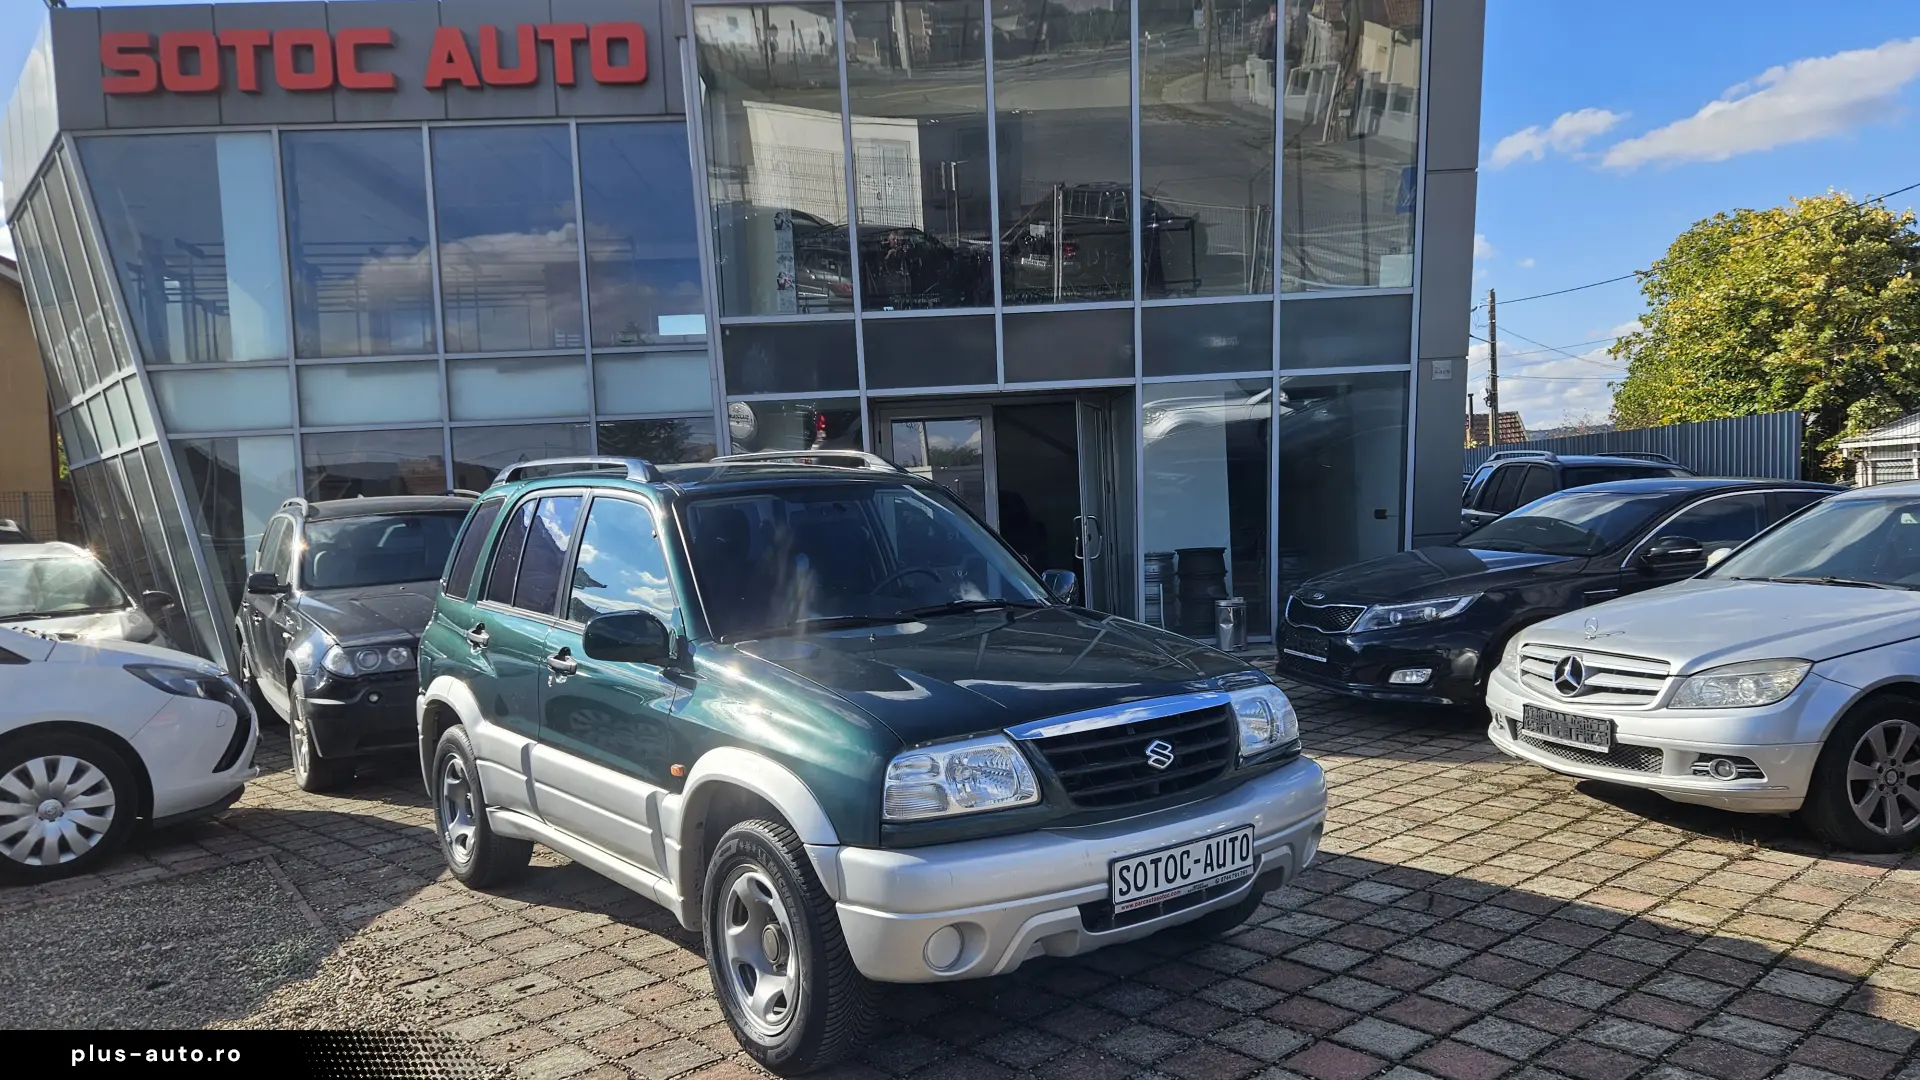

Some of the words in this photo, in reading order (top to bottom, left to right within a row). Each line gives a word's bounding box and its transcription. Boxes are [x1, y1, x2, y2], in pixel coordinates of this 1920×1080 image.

[100, 27, 397, 94] SOTOC
[423, 21, 649, 88] AUTO
[1118, 833, 1250, 897] SOTOC-AUTO
